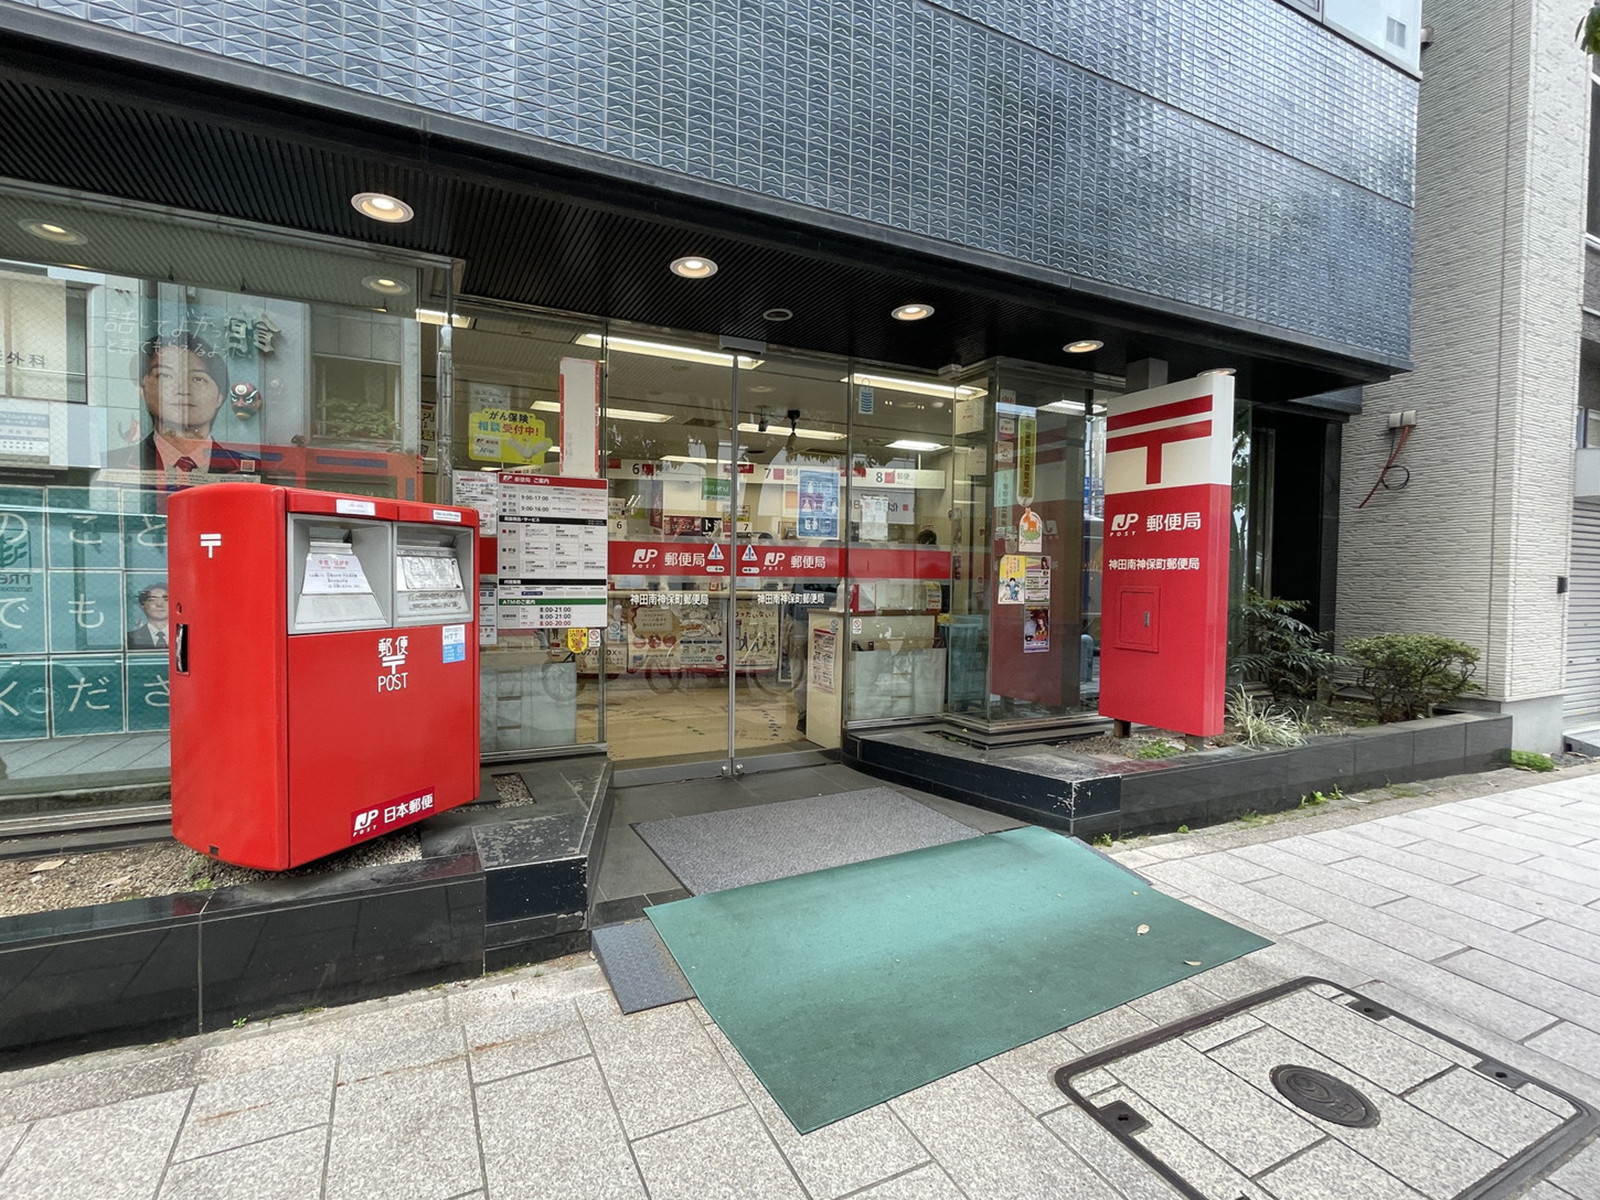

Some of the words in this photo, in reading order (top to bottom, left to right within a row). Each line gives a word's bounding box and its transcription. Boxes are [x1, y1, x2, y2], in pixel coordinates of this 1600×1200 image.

[0, 351, 45, 368] 外科
[632, 463, 640, 475] 6
[875, 472, 883, 483] 8
[616, 520, 622, 529] 6
[1146, 512, 1201, 532] 郵便局
[664, 552, 706, 568] 郵便局
[790, 555, 826, 569] 郵便局
[1108, 557, 1200, 571] 神田南神保町郵便局
[630, 593, 709, 606] 神田南神保町郵便局
[757, 593, 825, 604] 神田南神保町郵便局
[378, 636, 408, 657] 郵便
[378, 672, 408, 692] POST
[383, 793, 434, 824] 日本郵便
[352, 824, 378, 838] POST
